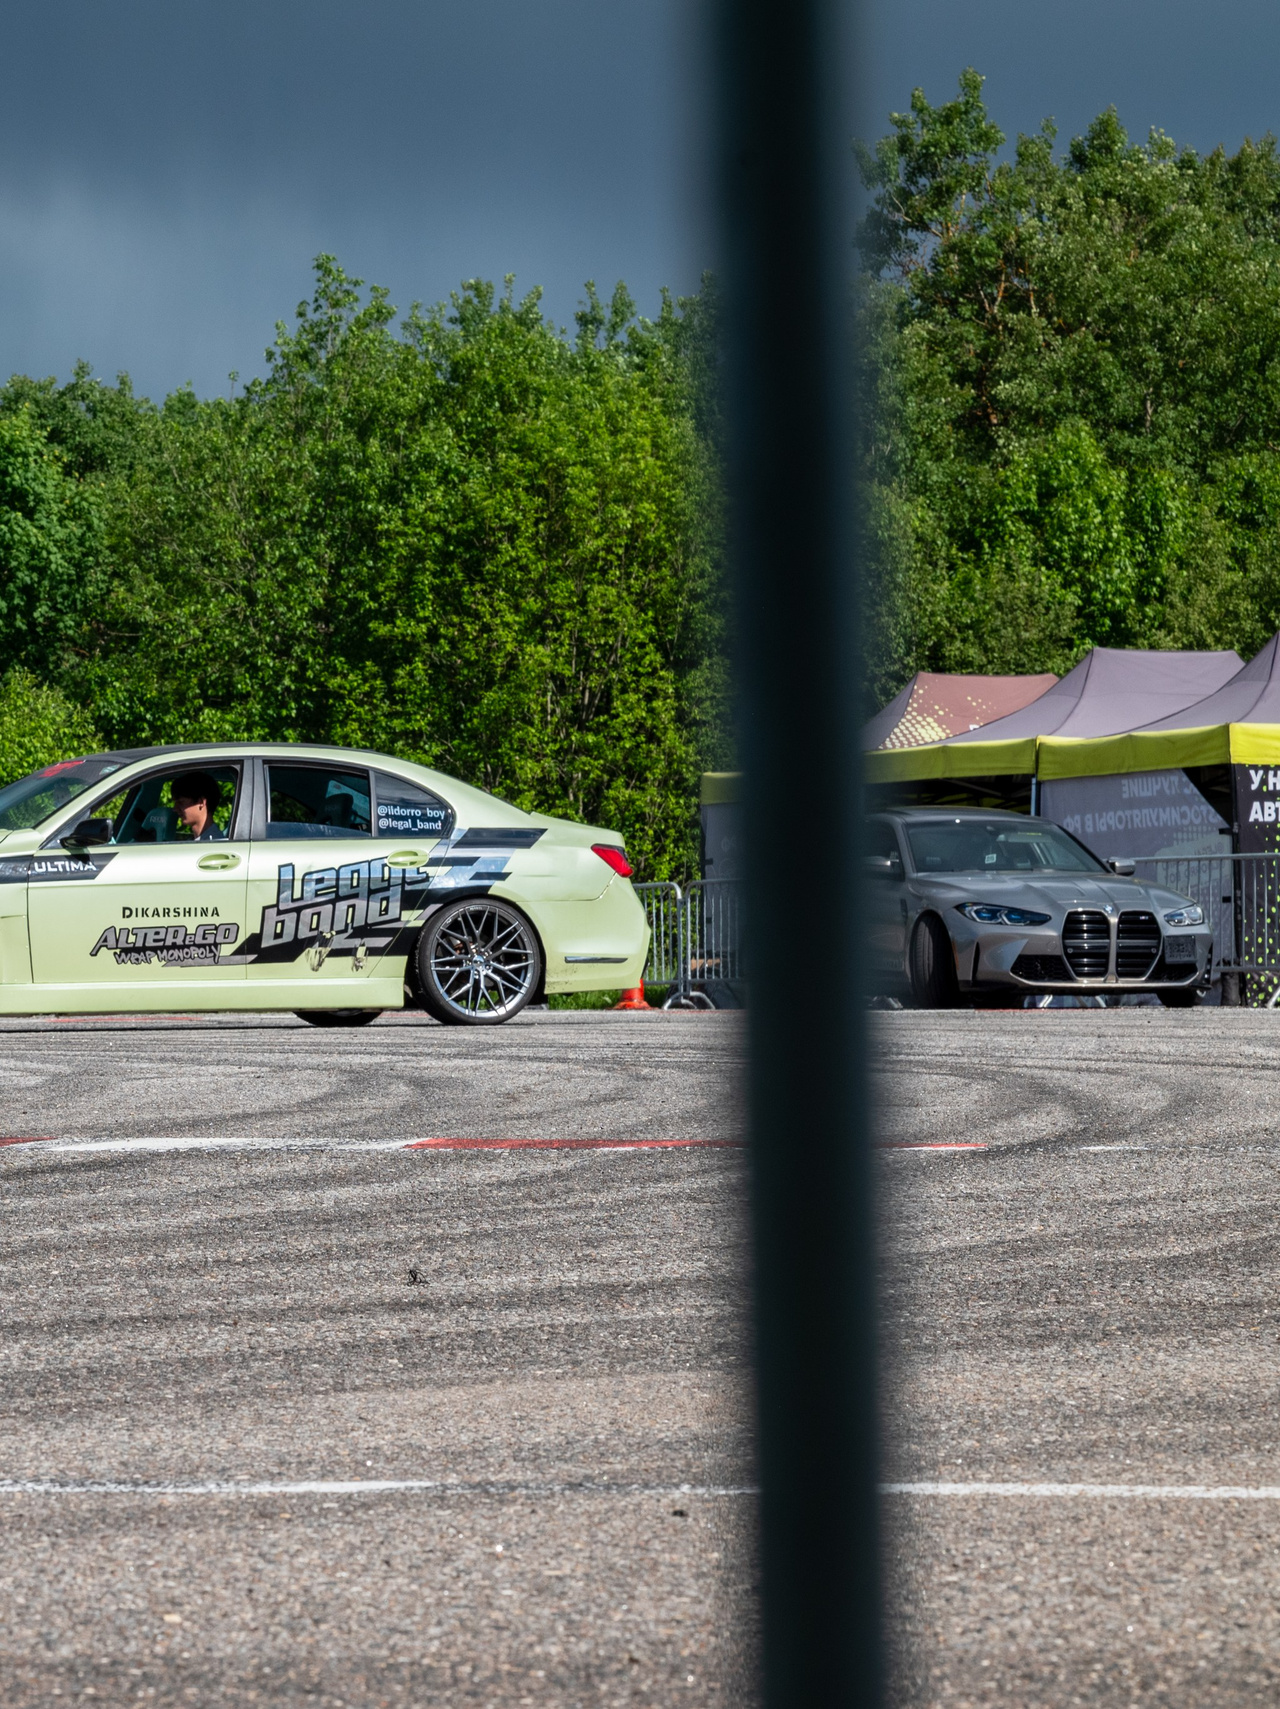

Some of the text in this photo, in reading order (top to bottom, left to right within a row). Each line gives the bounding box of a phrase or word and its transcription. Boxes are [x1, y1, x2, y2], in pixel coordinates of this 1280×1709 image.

[1249, 769, 1264, 791] У
[378, 818, 442, 831] @legal_band
[33, 860, 97, 873] ULTIMA
[121, 906, 220, 919] DIKARSHINA
[113, 945, 221, 965] WRAP MONOPOLY
